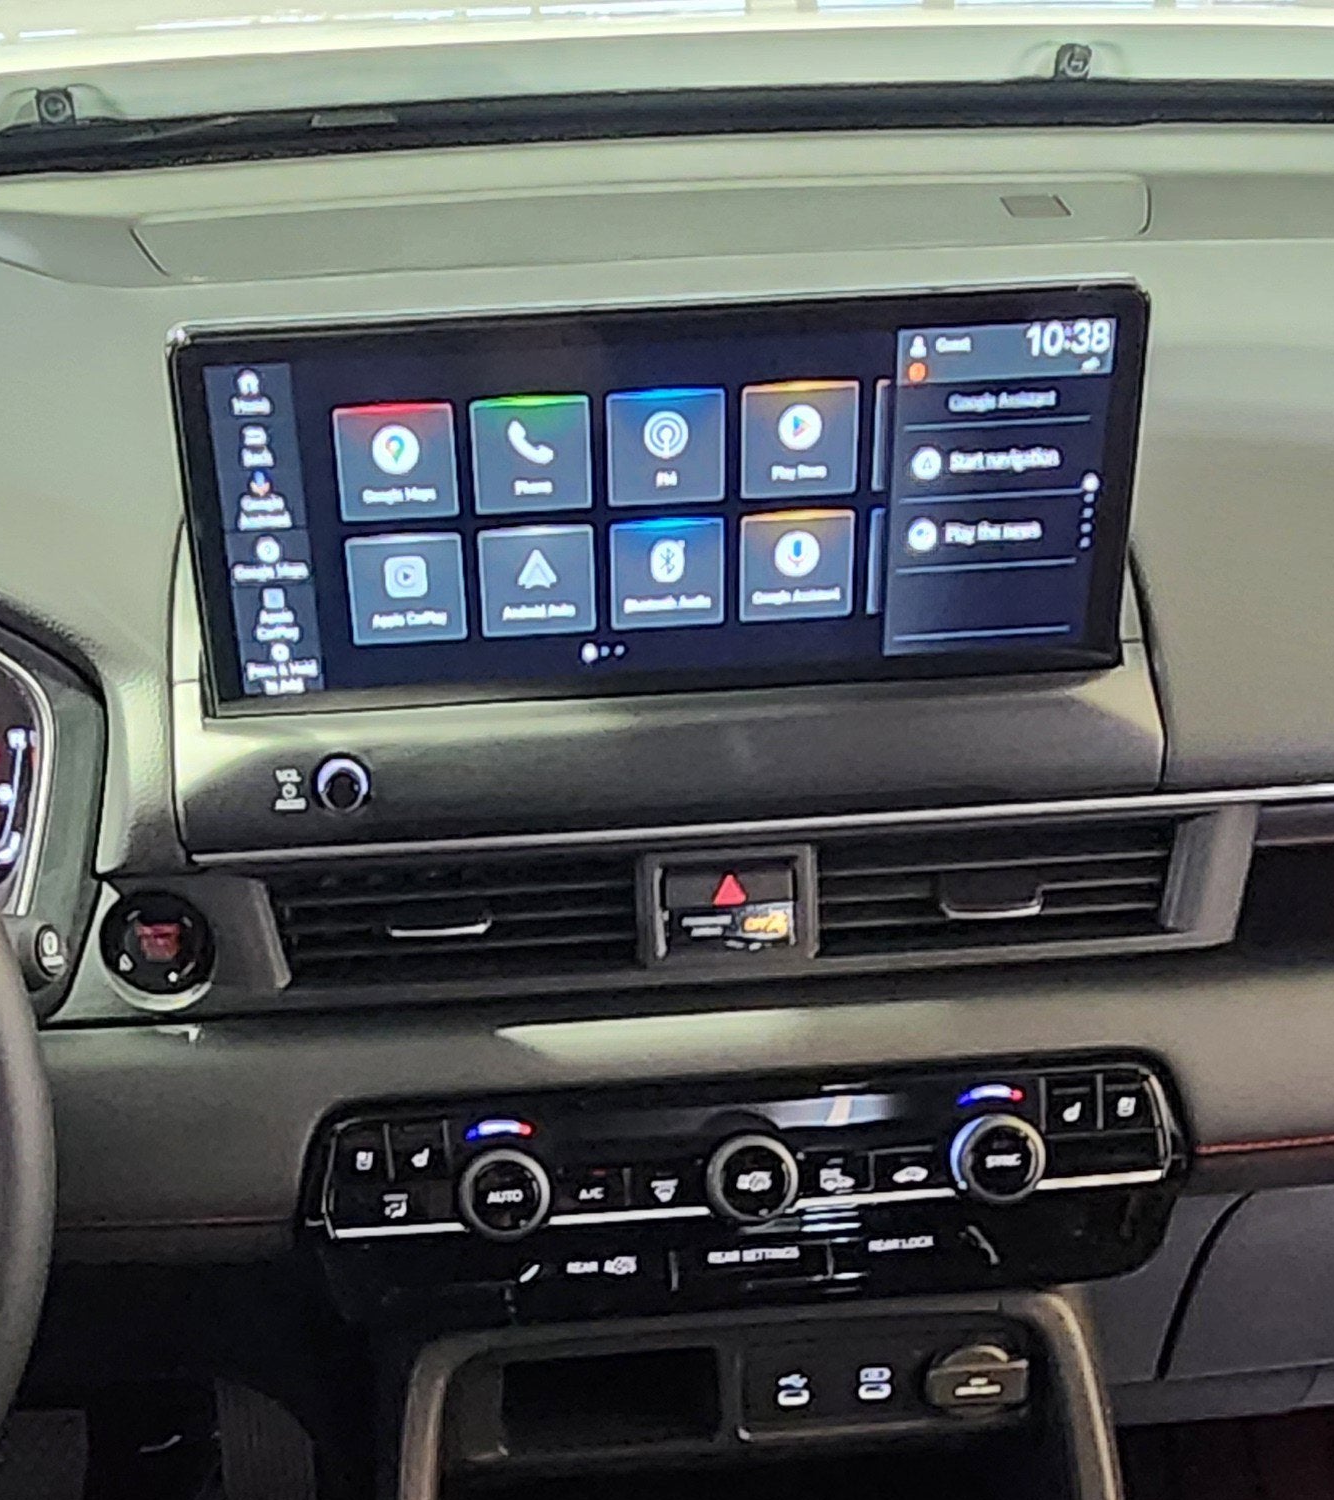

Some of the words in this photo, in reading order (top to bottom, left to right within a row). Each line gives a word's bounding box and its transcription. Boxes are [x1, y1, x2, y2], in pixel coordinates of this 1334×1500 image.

[1026, 319, 1111, 357] 10:38
[486, 1188, 525, 1205] AUTO
[578, 1187, 606, 1200] A/C
